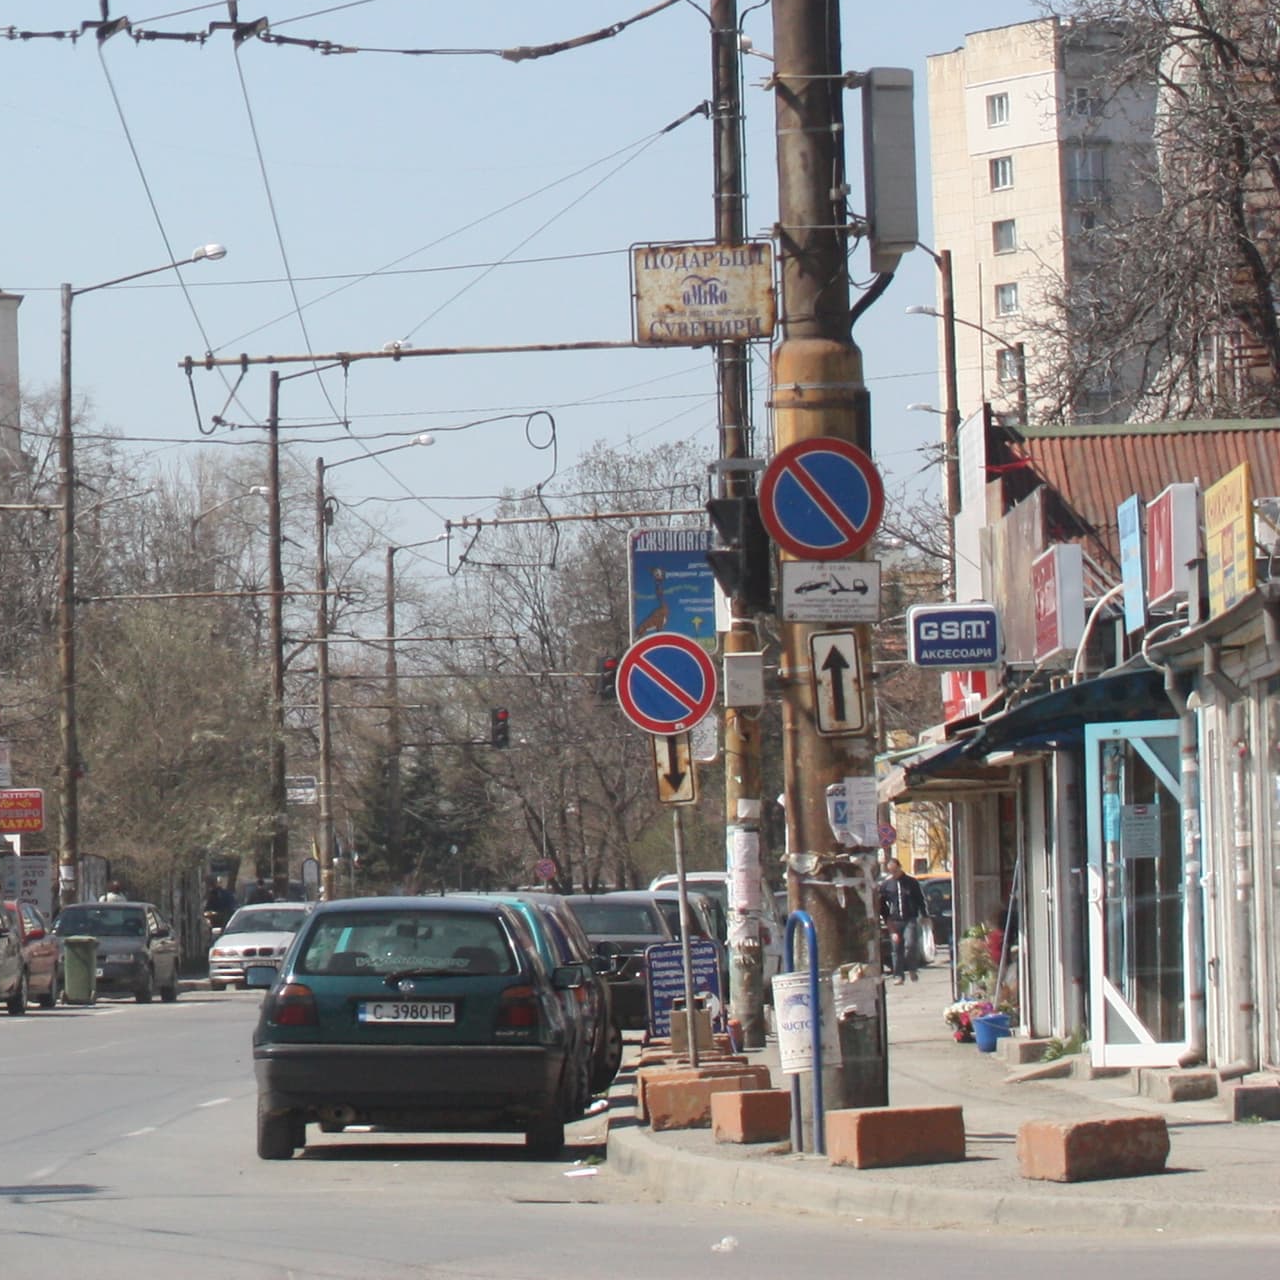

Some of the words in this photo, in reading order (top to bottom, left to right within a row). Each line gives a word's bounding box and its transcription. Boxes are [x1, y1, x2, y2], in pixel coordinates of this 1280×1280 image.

[644, 248, 764, 271] ПОДАРЪЦИ
[650, 317, 762, 337] СУВЕНИРИ
[920, 620, 987, 640] GSM
[921, 647, 992, 660] АКСЕСОАРИ
[373, 1004, 384, 1019] C
[391, 1004, 429, 1019] 3980
[431, 1004, 452, 1019] HP
